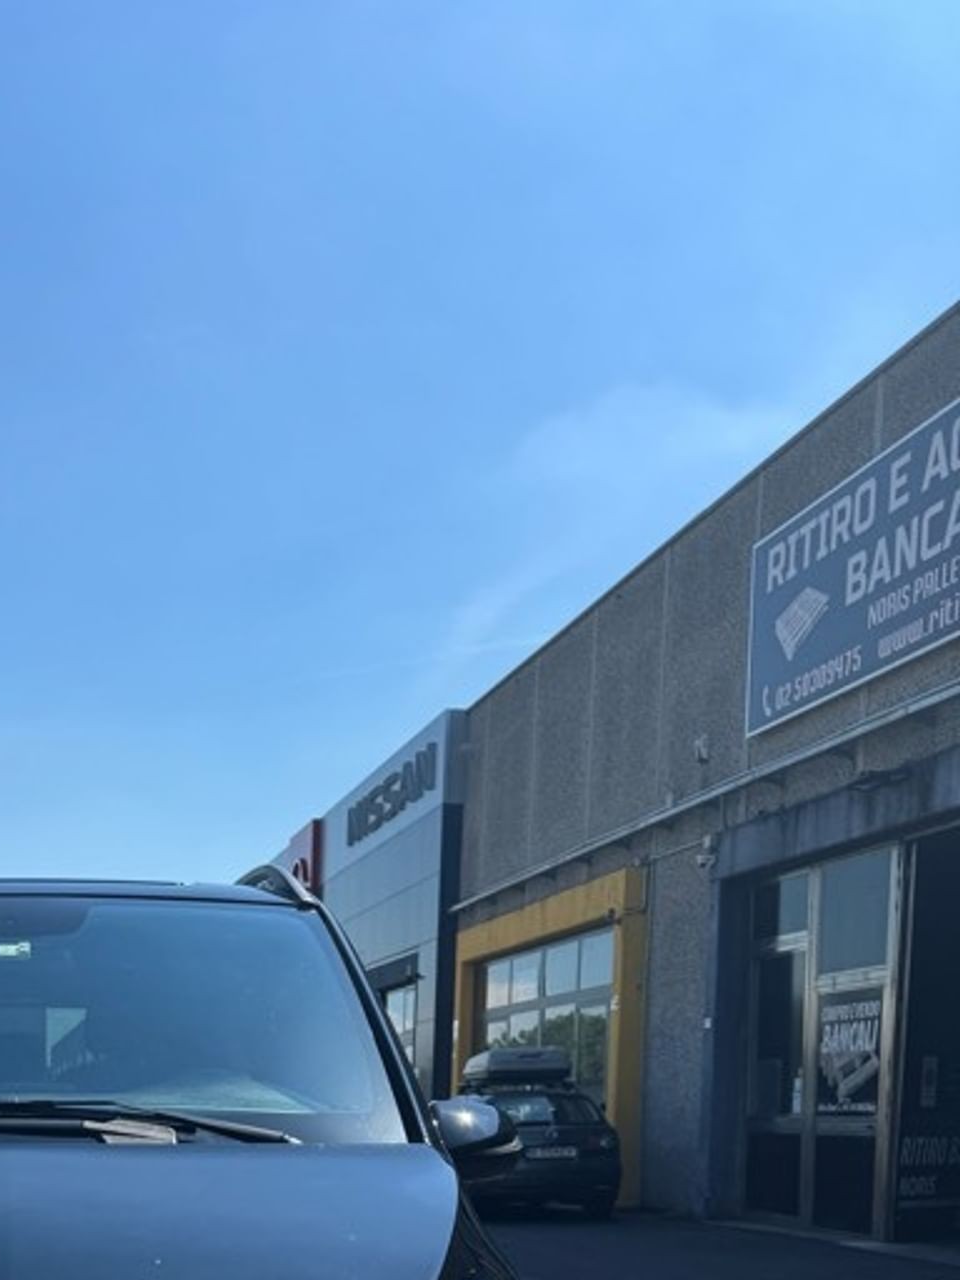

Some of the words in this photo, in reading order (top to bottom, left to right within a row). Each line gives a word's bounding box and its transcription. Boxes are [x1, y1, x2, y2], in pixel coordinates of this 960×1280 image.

[766, 477, 877, 594] RITIRO
[888, 451, 911, 513] E
[867, 583, 911, 630] NORIS
[347, 742, 438, 847] NISSAN
